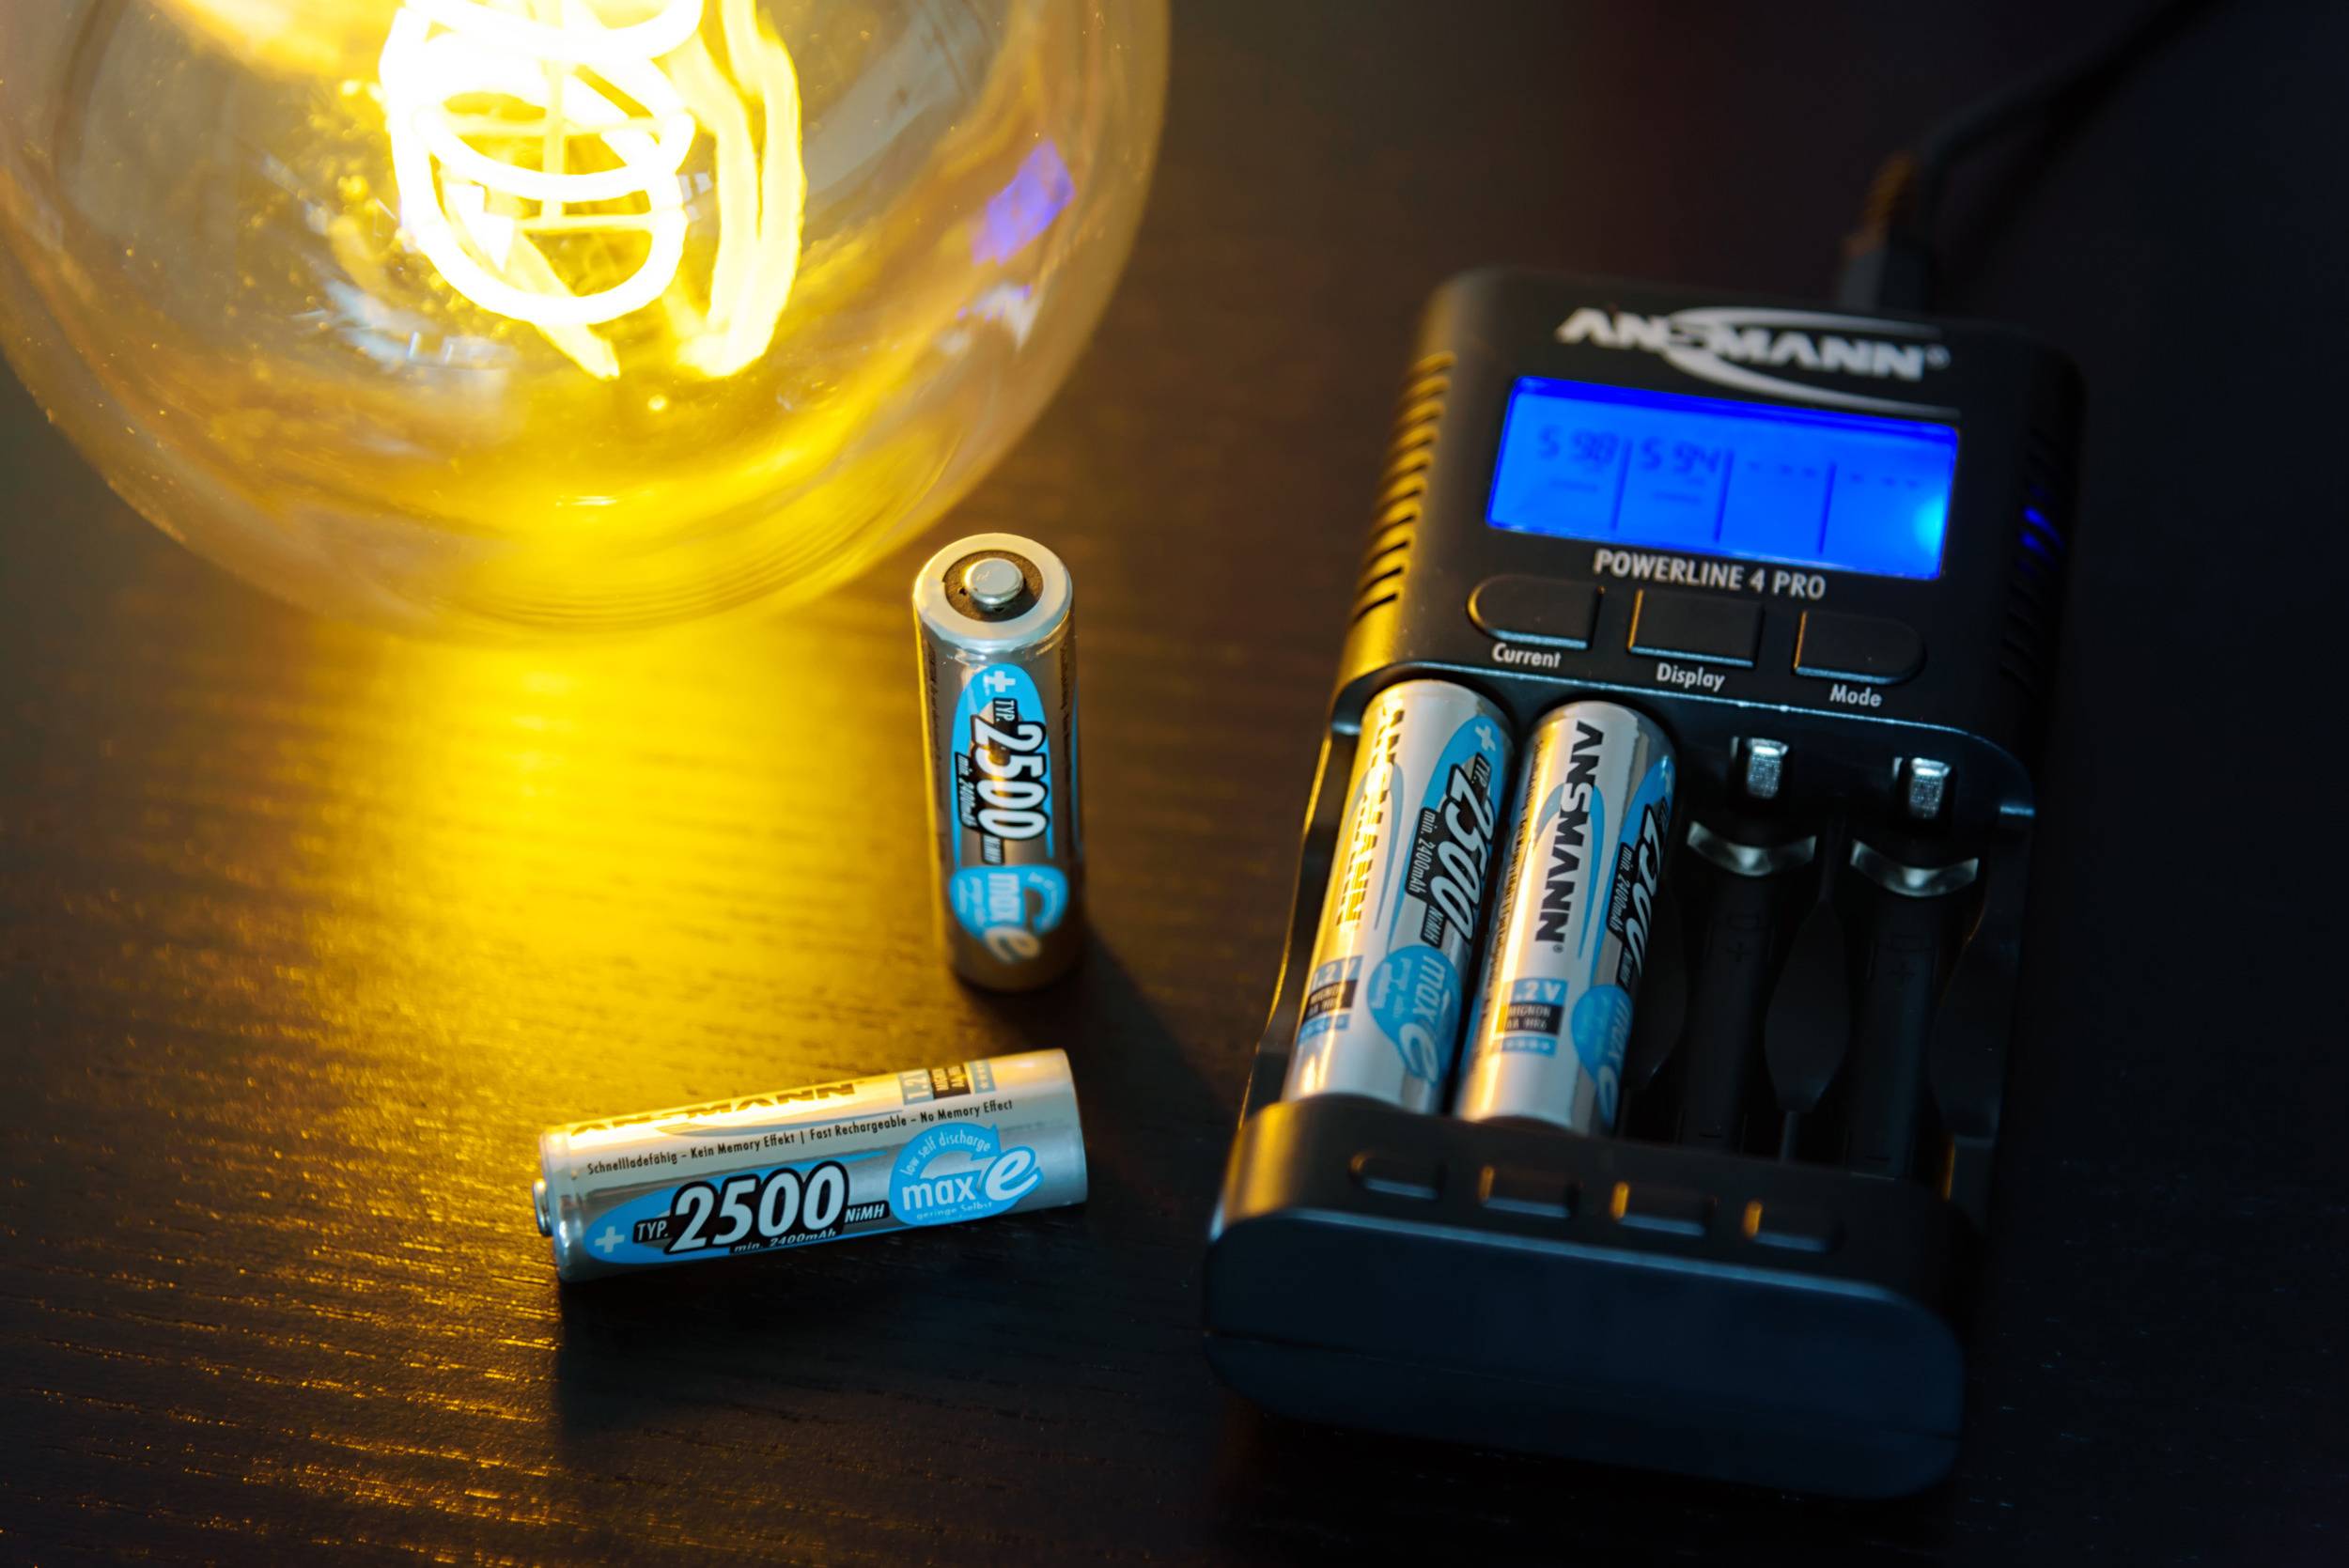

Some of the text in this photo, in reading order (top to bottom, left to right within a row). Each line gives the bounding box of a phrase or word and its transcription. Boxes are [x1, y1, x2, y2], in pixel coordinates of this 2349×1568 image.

[1595, 549, 1827, 599] POWERLINE 4 PRO
[1491, 643, 1562, 668] Current
[1657, 663, 1725, 691] Display
[995, 699, 1016, 722] TYP.
[1829, 684, 1881, 707] Mode
[974, 717, 1048, 839] 2500
[1409, 811, 1439, 893] min. 2400mAh
[1431, 768, 1494, 939] 2500
[587, 1152, 677, 1175] Schnellladefähig
[691, 1145, 714, 1158] Kein
[718, 1139, 761, 1157] Memory
[764, 1131, 796, 1148] Effekt
[810, 1127, 832, 1141] Fast
[834, 1114, 908, 1137] Rechargeable
[920, 1110, 935, 1124] No
[938, 1103, 980, 1121] Memory
[983, 1099, 1014, 1114] Effect
[899, 1129, 991, 1175] low self discharge
[637, 1164, 885, 1253] TYP. 2500 NiMH
[902, 1175, 976, 1211] max
[734, 1229, 836, 1252] min. 2400mAh
